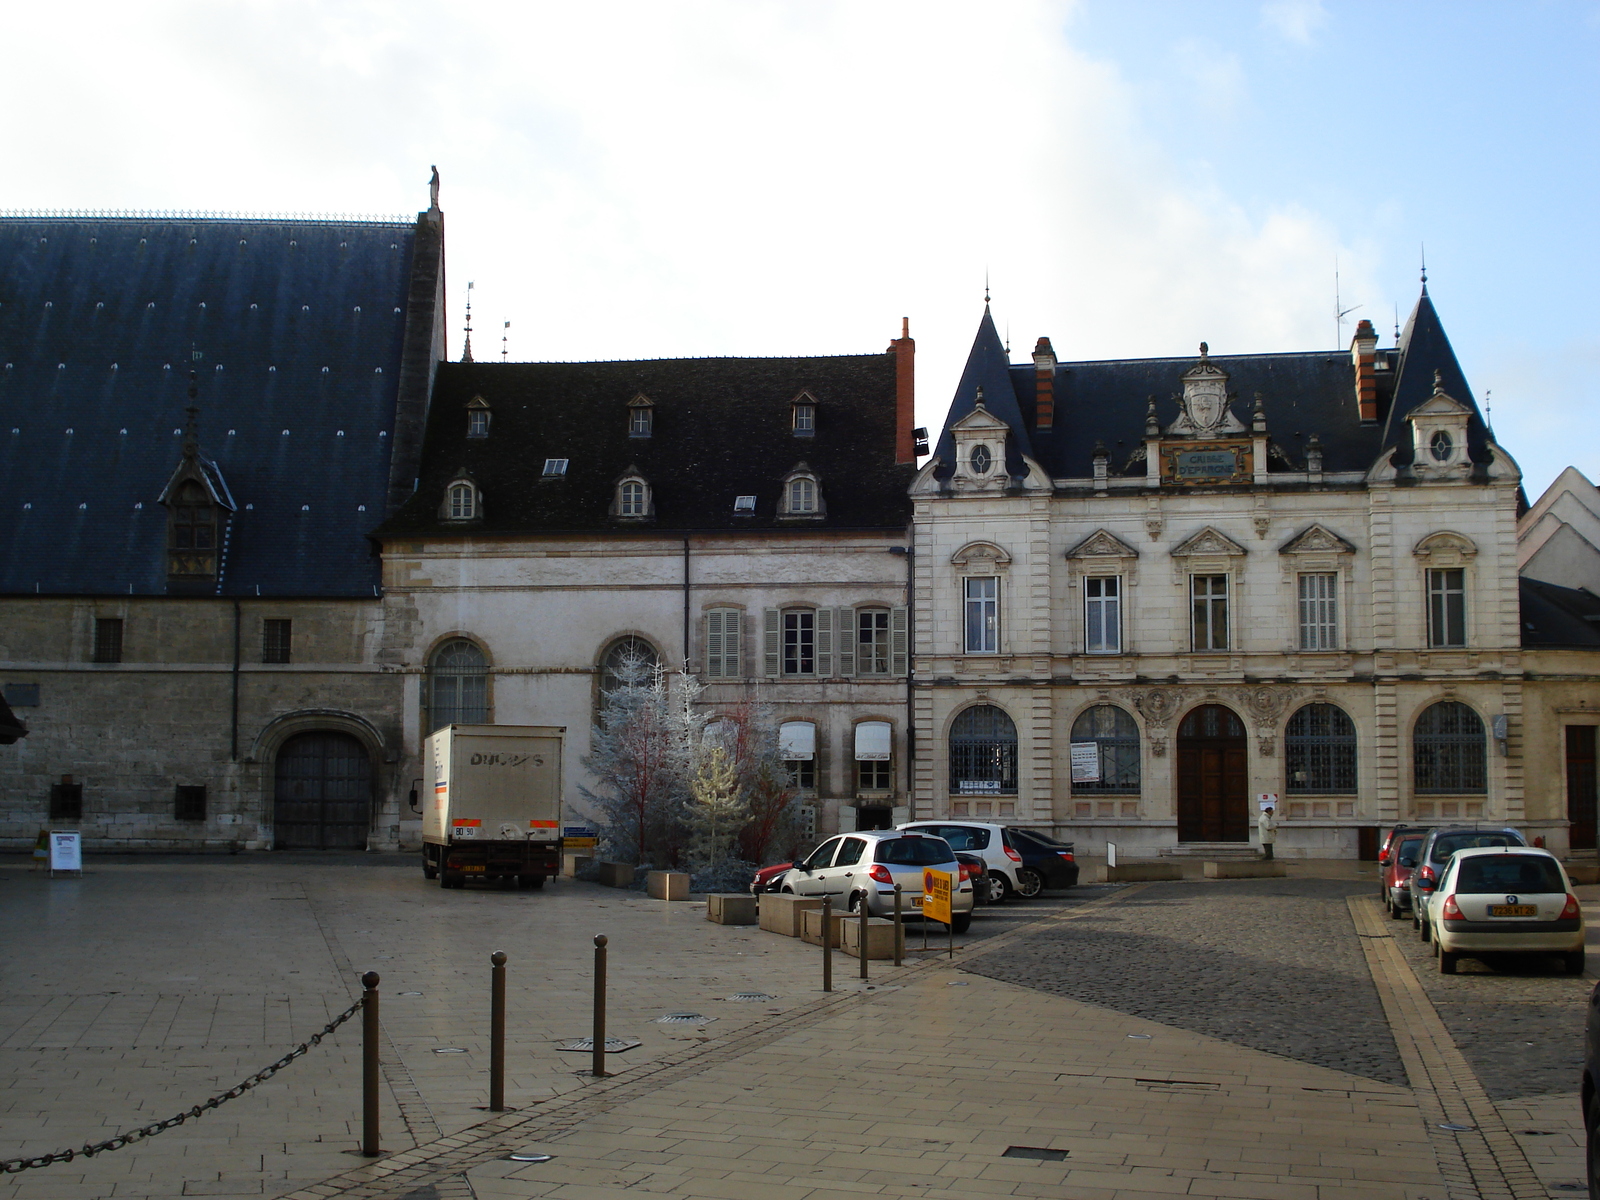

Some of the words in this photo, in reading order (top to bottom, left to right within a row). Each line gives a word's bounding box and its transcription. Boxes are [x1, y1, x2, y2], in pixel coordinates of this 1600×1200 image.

[456, 828, 463, 836] 80
[466, 828, 474, 836] 90
[1493, 906, 1513, 915] 7236
[1513, 906, 1524, 915] WT
[1525, 906, 1535, 915] 26
